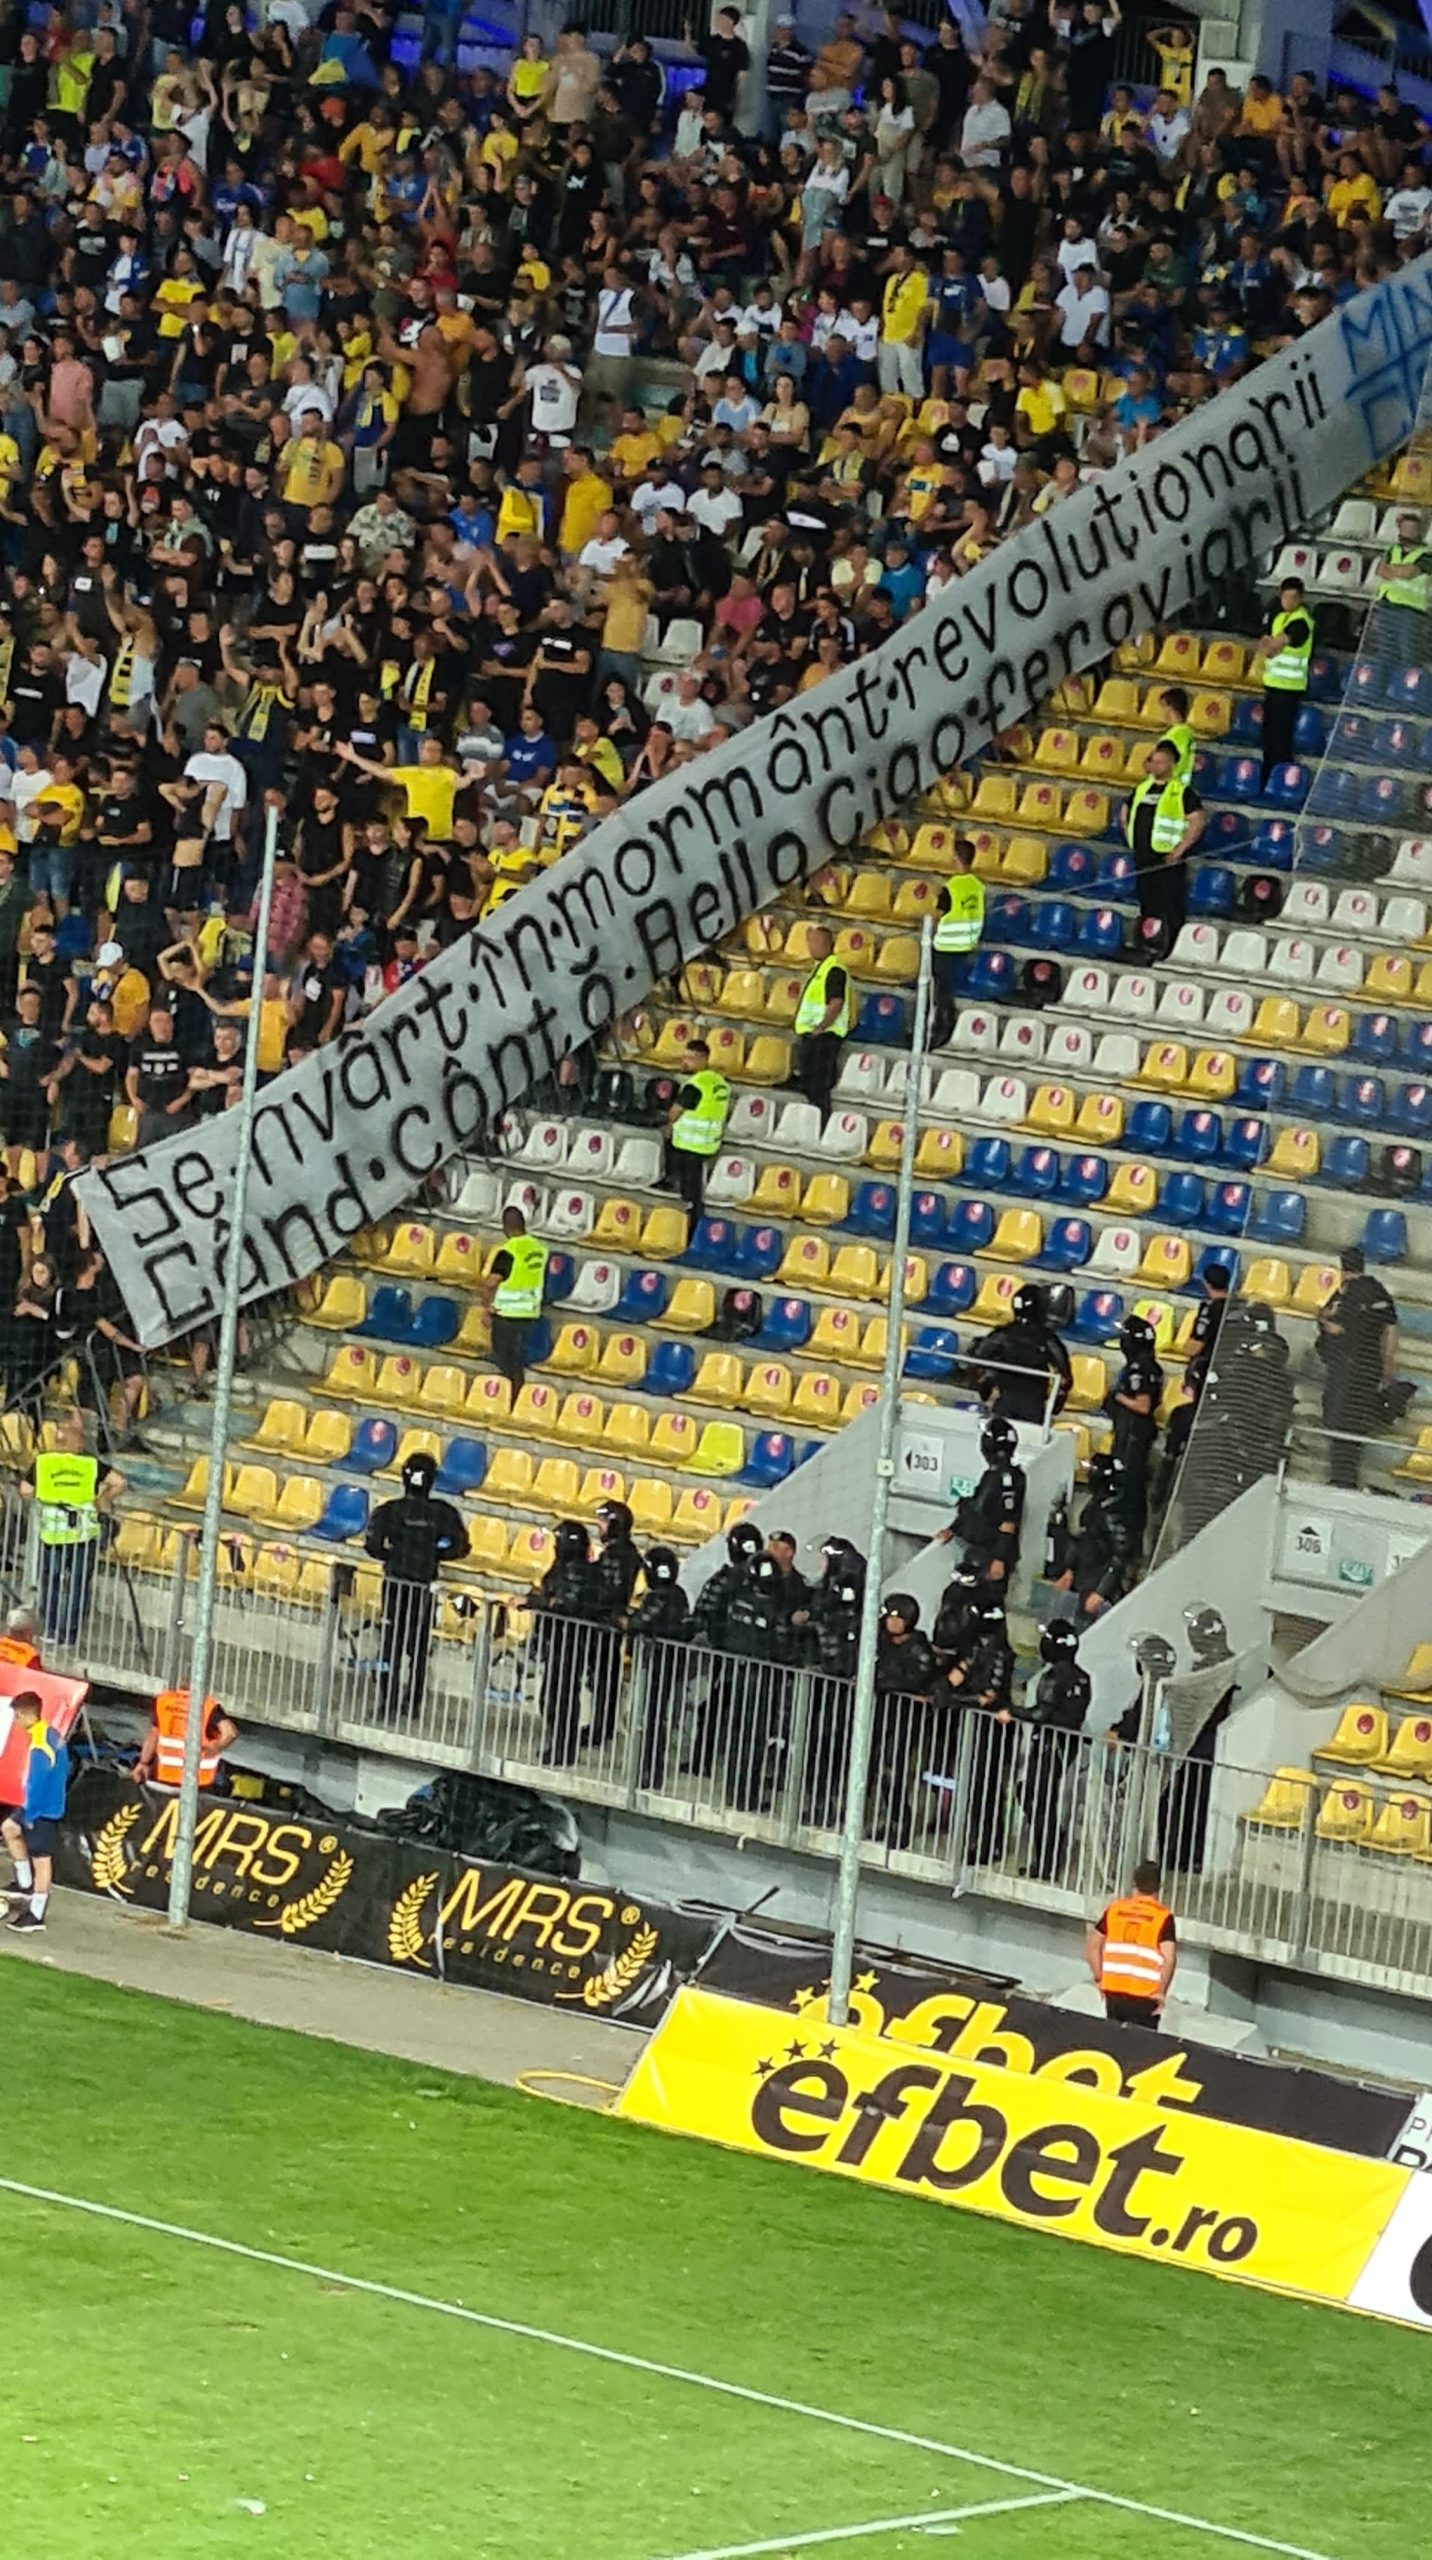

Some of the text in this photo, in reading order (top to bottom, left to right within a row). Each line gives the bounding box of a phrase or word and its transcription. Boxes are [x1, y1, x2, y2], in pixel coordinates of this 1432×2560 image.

[547, 668, 888, 948] mormânt
[818, 712, 966, 850] Ciao
[914, 1454, 938, 1471] 303
[140, 1798, 313, 1886] MRS
[427, 1932, 583, 1980] residence
[439, 1868, 615, 1957] MRS
[751, 2059, 1258, 2262] efbet.ro
